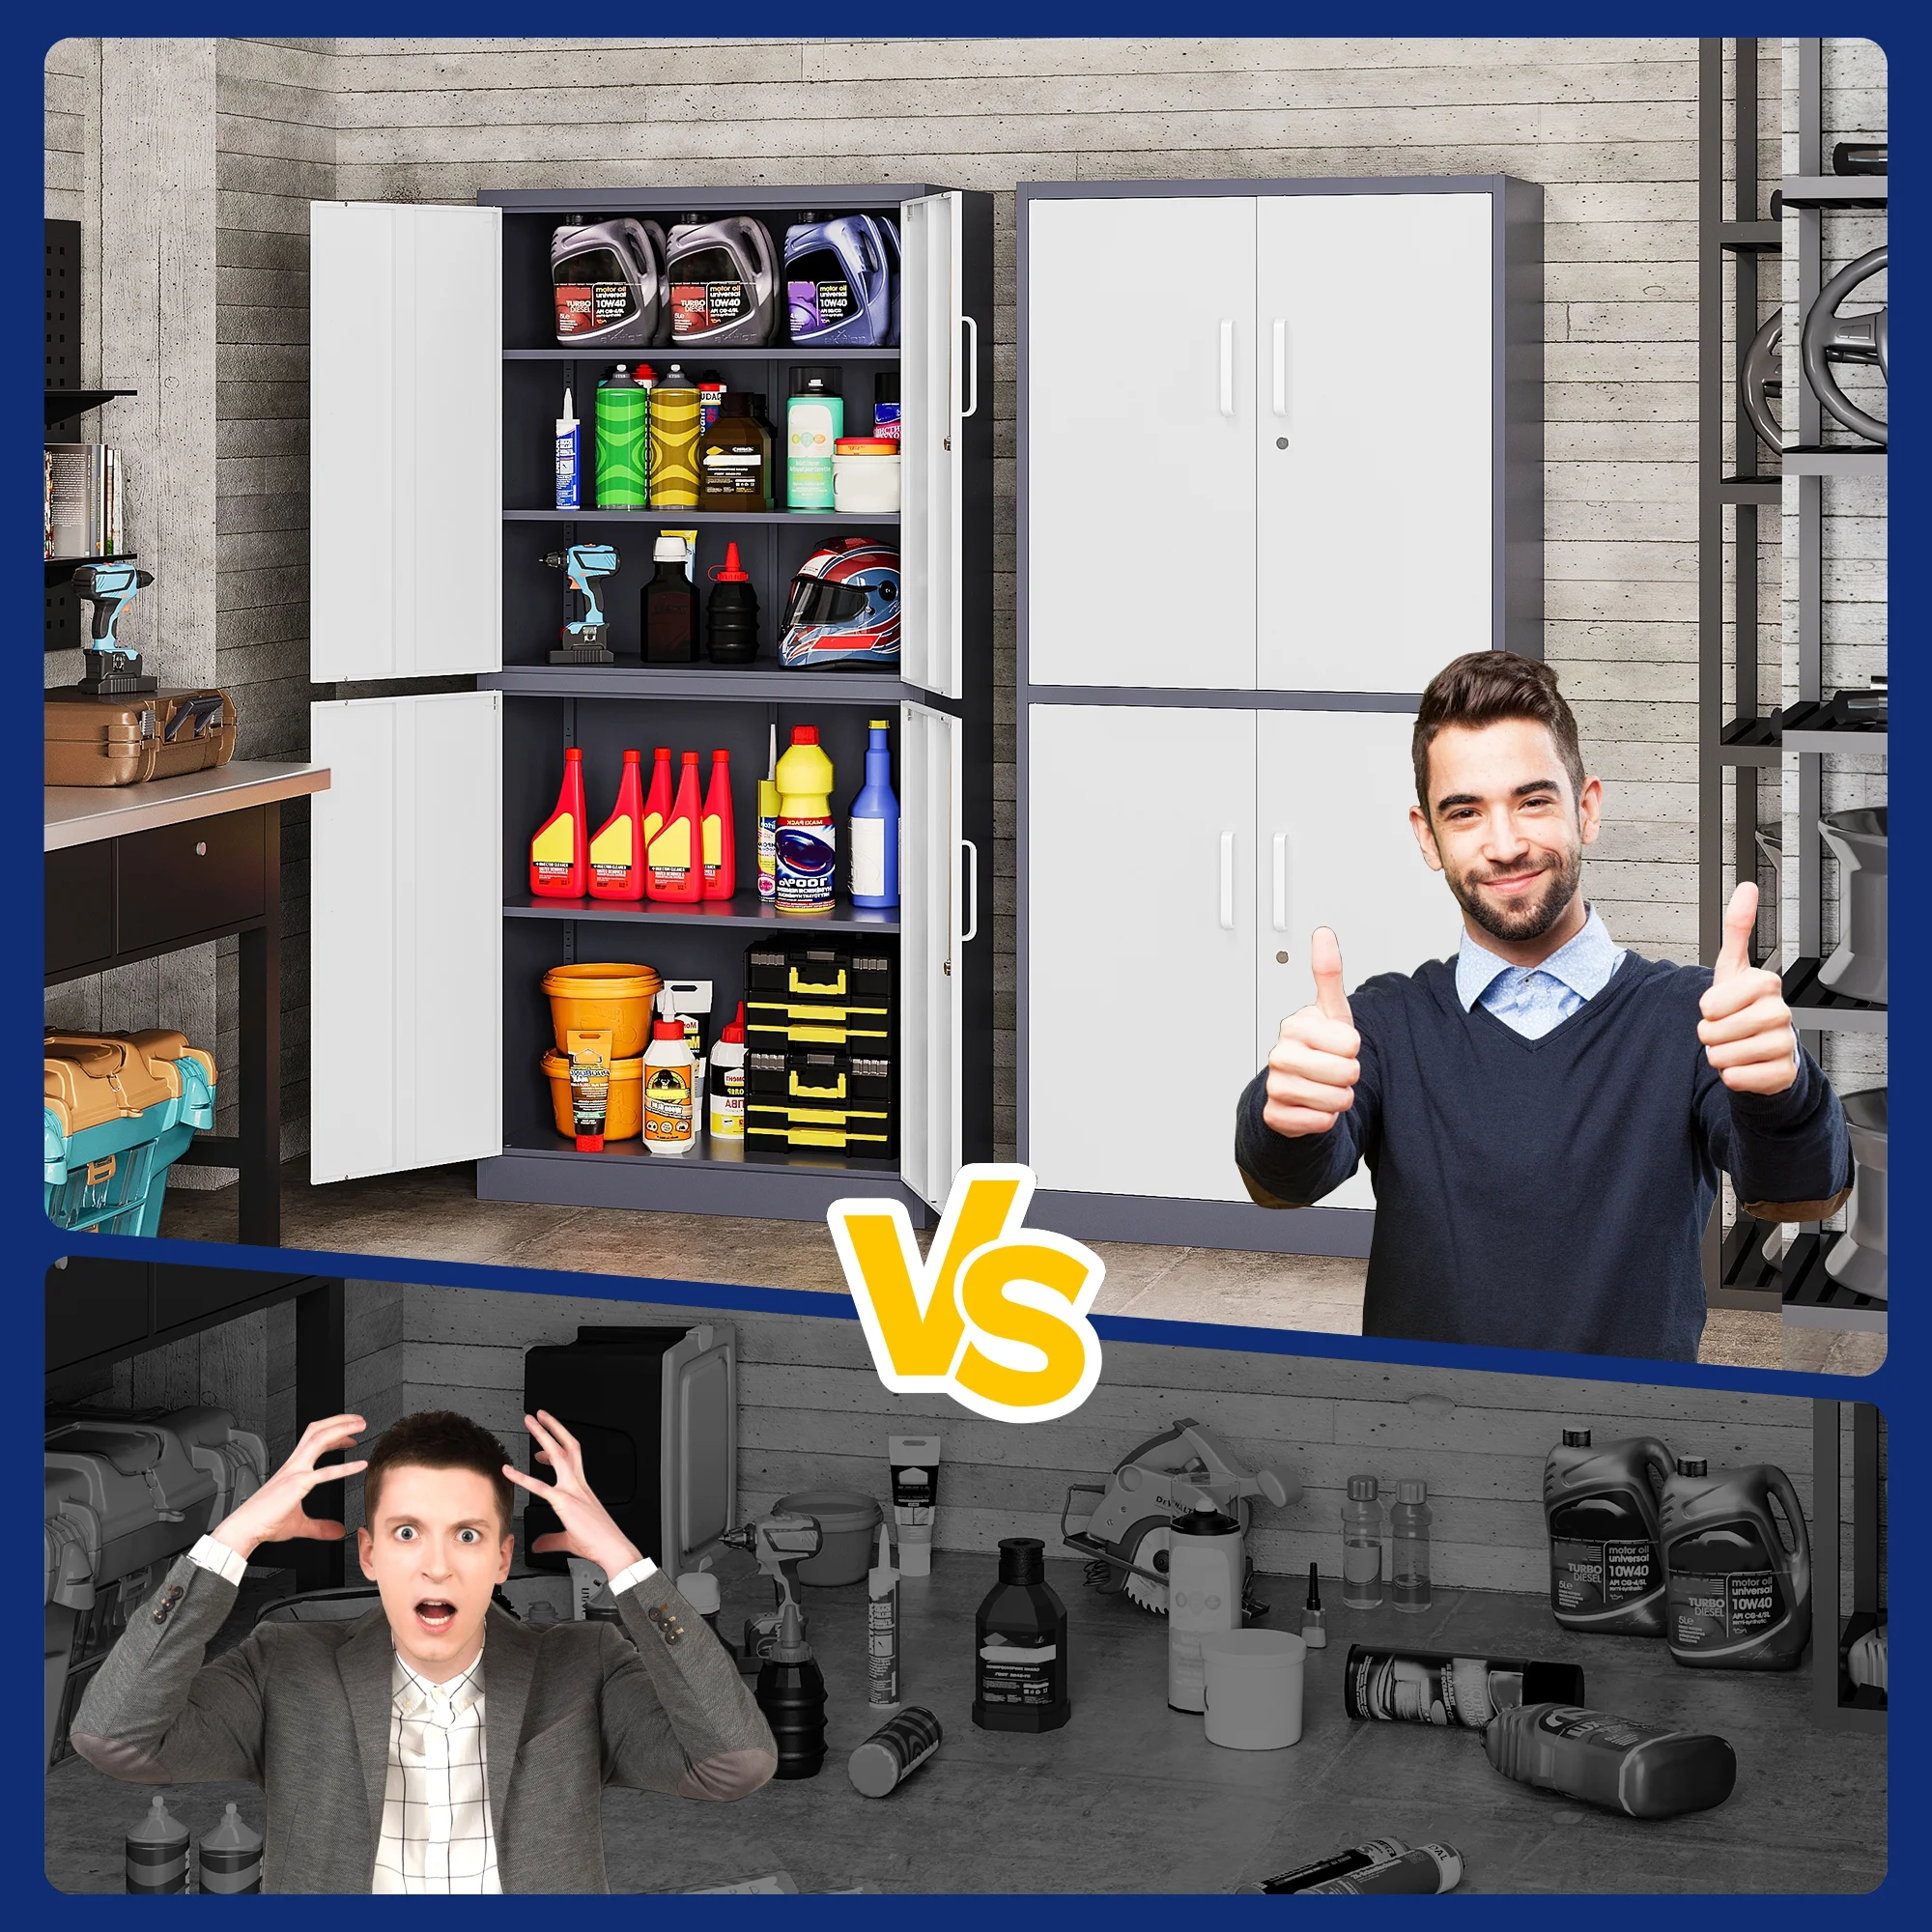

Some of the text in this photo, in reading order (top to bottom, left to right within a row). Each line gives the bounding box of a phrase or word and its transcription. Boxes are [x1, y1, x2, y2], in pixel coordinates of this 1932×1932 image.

[710, 298, 740, 307] 10W40
[706, 409, 716, 422] B2
[1609, 1553, 1649, 1563] universal
[1568, 1563, 1603, 1575] TURBO
[1609, 1565, 1649, 1577] 10W40
[1574, 1573, 1602, 1583] DIESEL
[1558, 1580, 1573, 1590] 5Le
[1732, 1585, 1772, 1596] universal
[1689, 1597, 1724, 1607] TURBO
[1732, 1597, 1772, 1610] 10W40
[1694, 1607, 1724, 1617] DIESEL
[1678, 1615, 1693, 1625] 5Le
